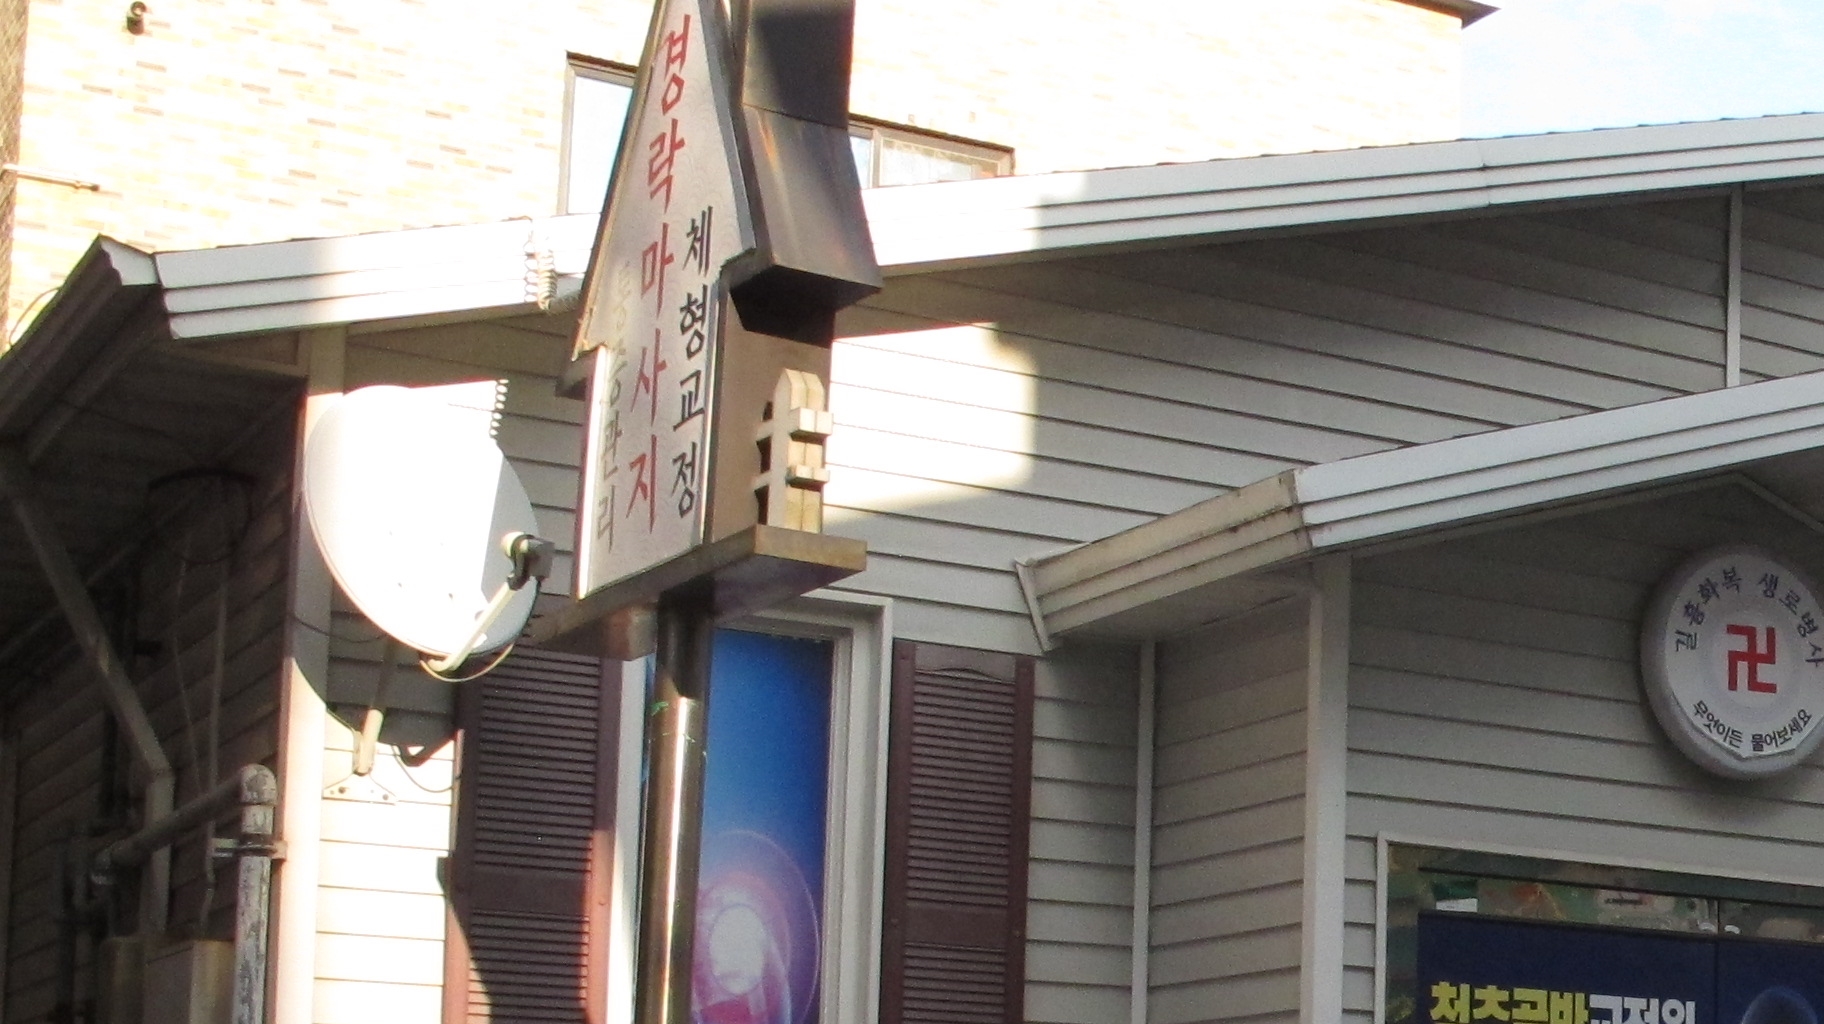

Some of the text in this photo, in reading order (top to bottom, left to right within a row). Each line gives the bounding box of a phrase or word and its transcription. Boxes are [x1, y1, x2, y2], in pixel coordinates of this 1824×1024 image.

[626, 14, 692, 533] 경락마사지
[672, 206, 714, 518] 체형교정
[1675, 566, 1743, 652] 길흉화복
[1693, 700, 1812, 752] 무엇이든 물어보세요
